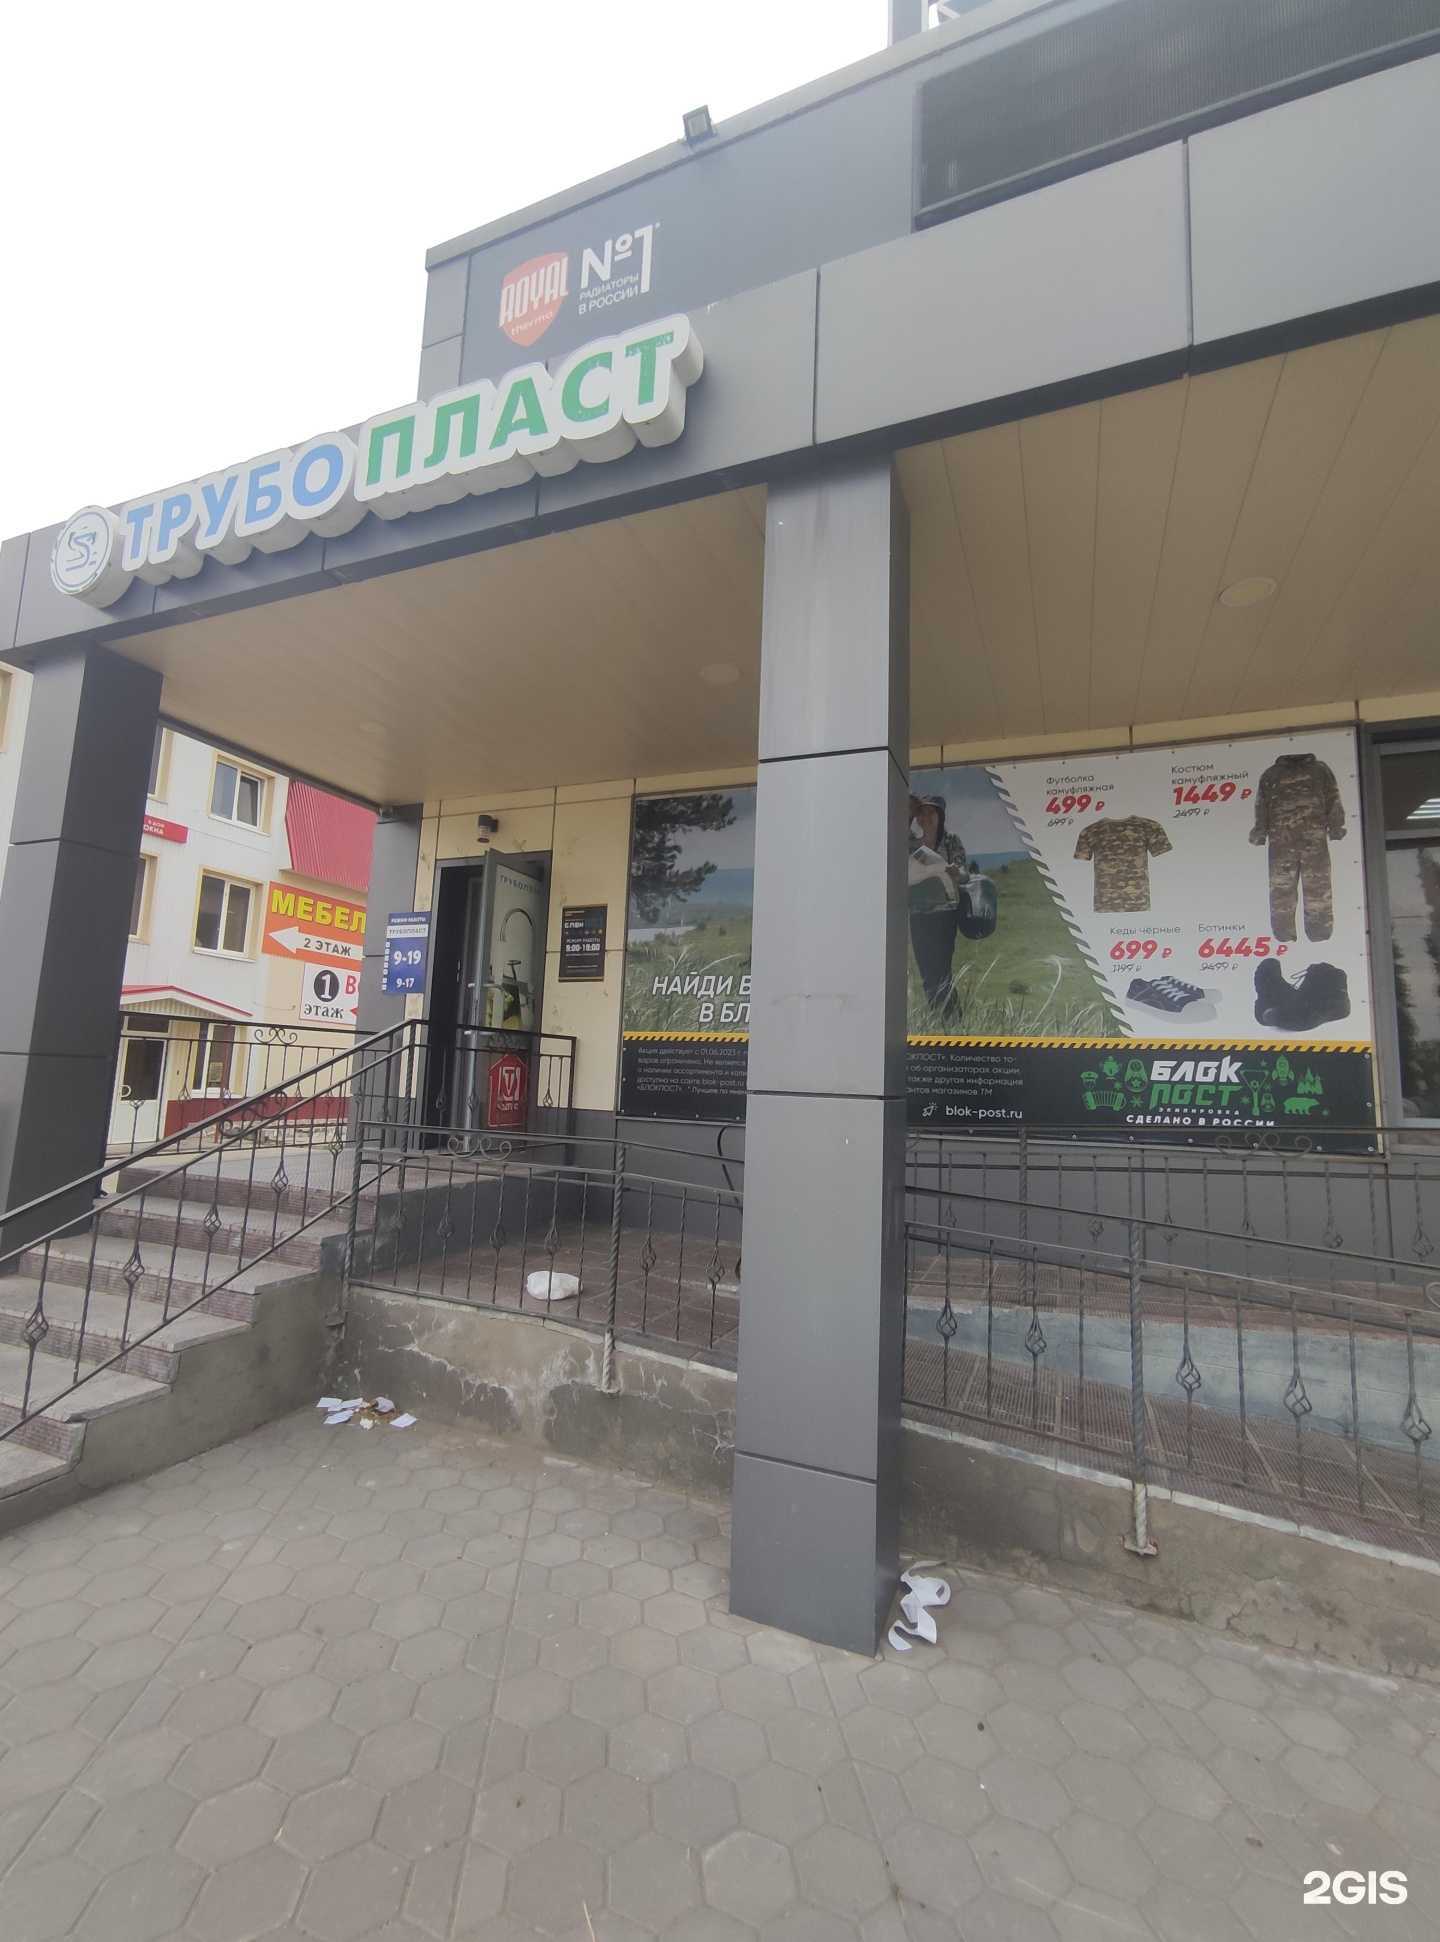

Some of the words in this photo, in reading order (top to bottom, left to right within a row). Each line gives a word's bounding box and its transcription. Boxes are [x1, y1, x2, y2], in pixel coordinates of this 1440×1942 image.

[579, 272, 640, 300] РАДИАТОРЫ
[578, 303, 587, 315] В
[588, 285, 640, 311] РОССИИ
[126, 331, 674, 560] ТРУБОПЛАСТ
[1171, 763, 1214, 774] Костюм
[1171, 771, 1248, 786] камуфляжный
[1046, 774, 1094, 785] Футболка
[1046, 783, 1114, 796] камуфляжная
[1045, 794, 1092, 814] 499
[1173, 782, 1236, 806] 1449
[271, 889, 366, 934] МЕБЕЛ
[1110, 927, 1136, 936] Кеды
[1199, 924, 1246, 933] Ботинки
[304, 938, 311, 948] 2
[315, 940, 351, 956] ЭТАЖ
[1110, 939, 1158, 960] 699
[1198, 936, 1271, 959] 6445
[394, 950, 421, 965] 9-19
[320, 973, 332, 999] 1
[345, 975, 358, 995] В
[396, 977, 415, 988] 9-17
[652, 971, 734, 998] НАЙДИ
[739, 975, 752, 995] В
[304, 1003, 344, 1019] этаж
[699, 1002, 714, 1023] В
[720, 1002, 750, 1023] БЛ
[1150, 1055, 1243, 1083] БЛОК
[1150, 1083, 1243, 1108] ПОСТ
[945, 1104, 1023, 1119] blok-post.ru
[1126, 1114, 1192, 1126] СДЕЛАНО
[1198, 1117, 1206, 1126] В
[1212, 1118, 1275, 1126] РОССИИ
[1158, 1106, 1240, 1116] ЭКИПИРОВКА
